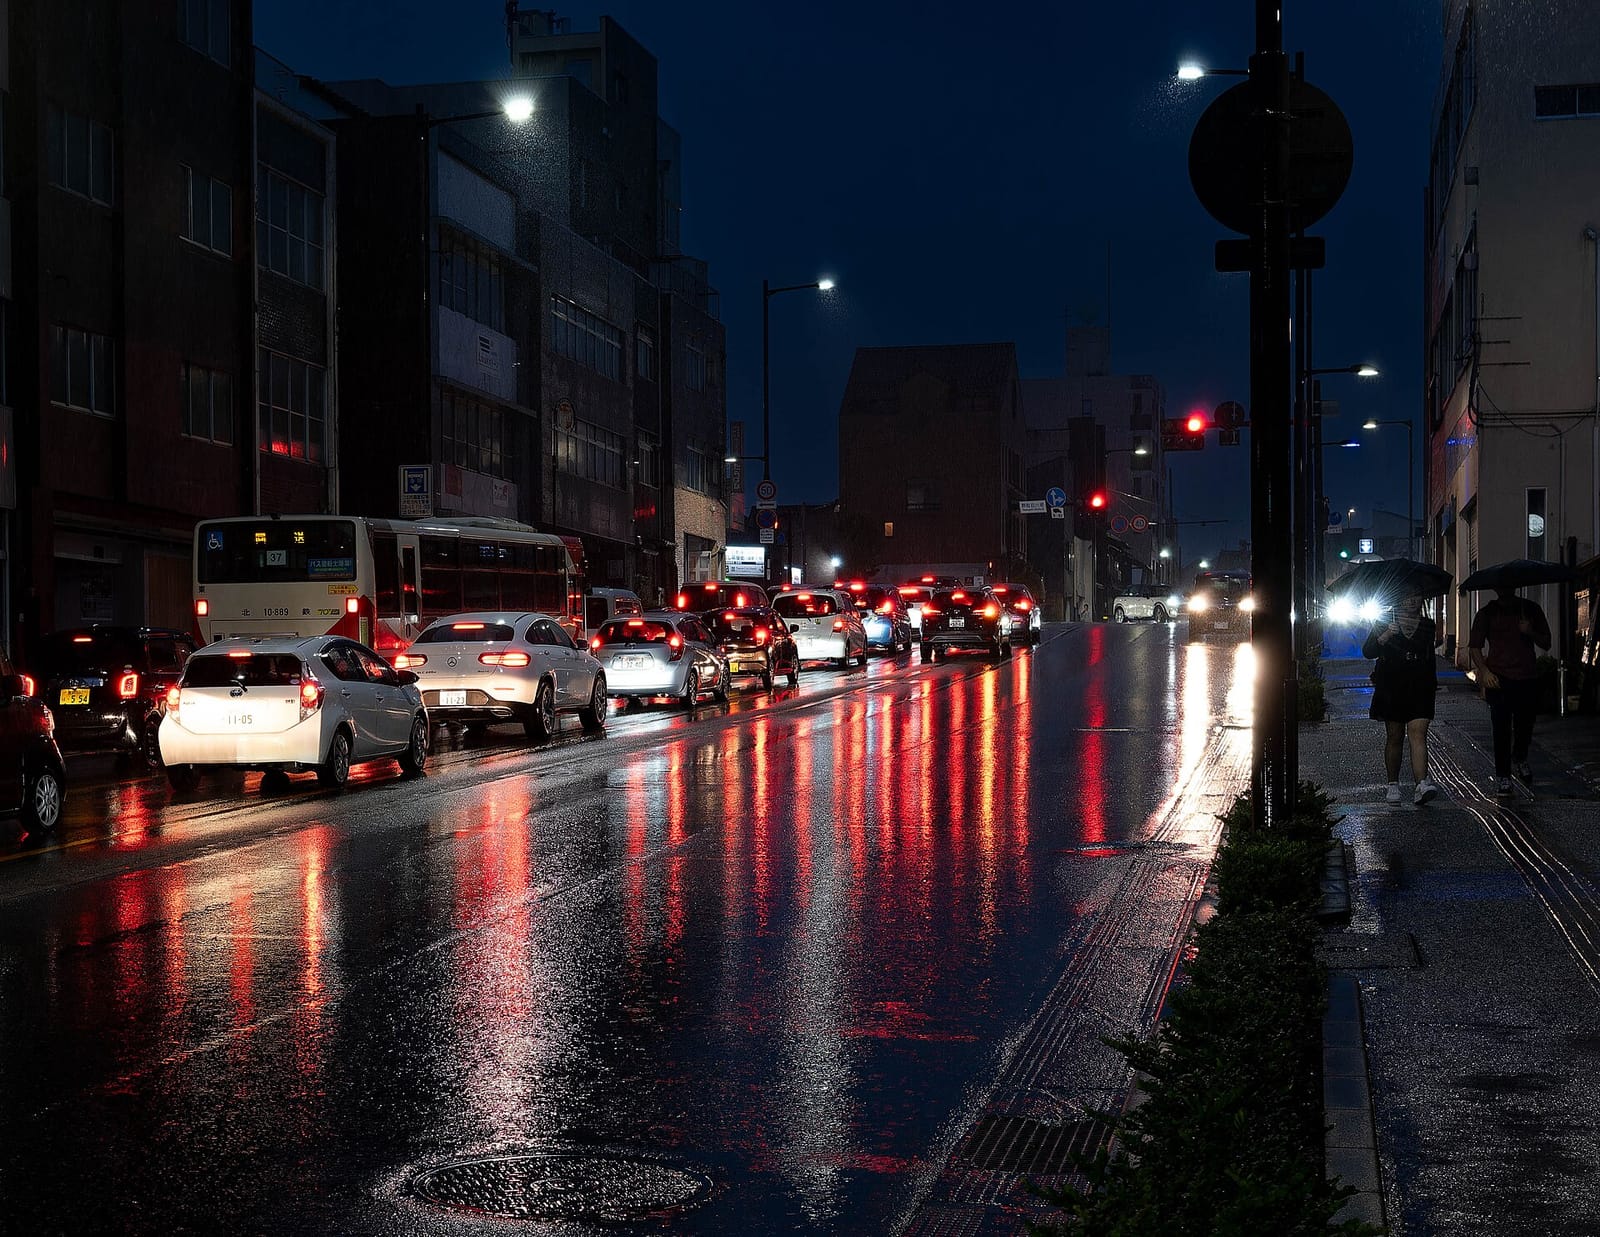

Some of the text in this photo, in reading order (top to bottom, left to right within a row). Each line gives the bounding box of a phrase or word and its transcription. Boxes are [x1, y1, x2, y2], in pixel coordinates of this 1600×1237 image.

[760, 486, 773, 495] 50
[270, 552, 282, 562] 37
[241, 608, 251, 616] 北
[445, 696, 465, 705] 11-23
[227, 714, 253, 725] 11-05
